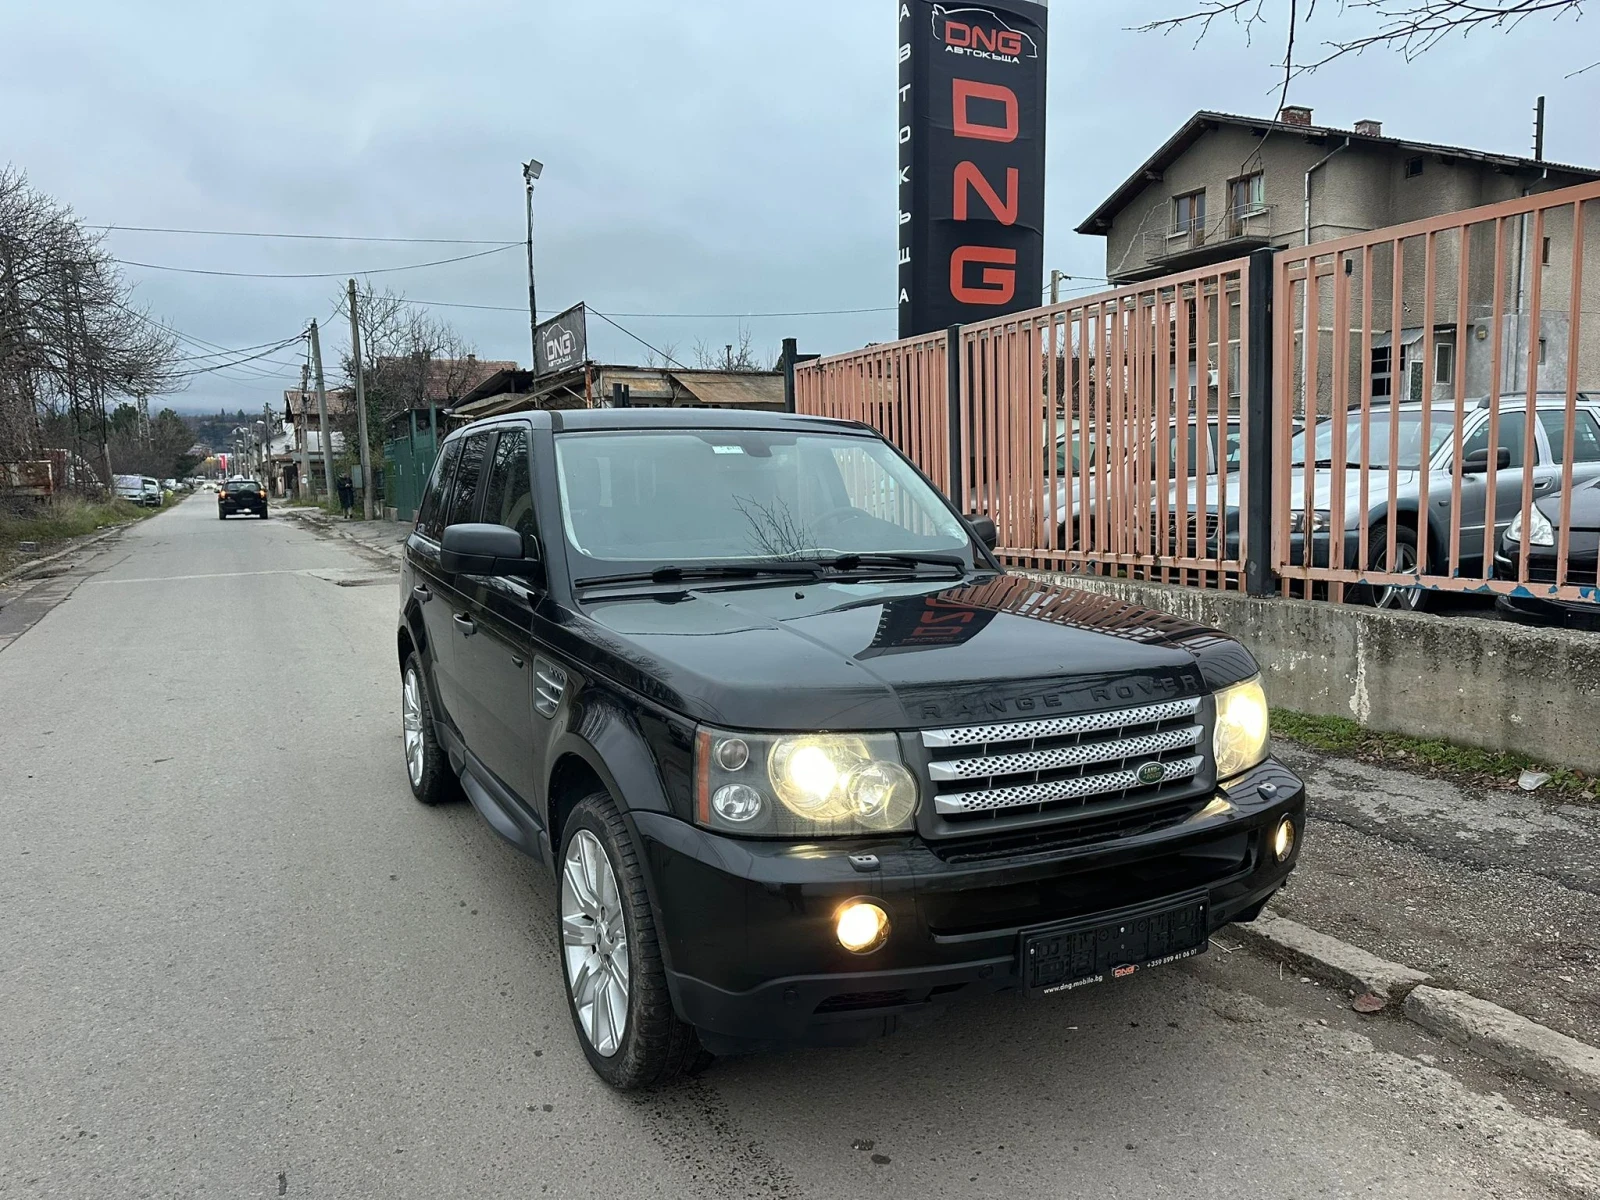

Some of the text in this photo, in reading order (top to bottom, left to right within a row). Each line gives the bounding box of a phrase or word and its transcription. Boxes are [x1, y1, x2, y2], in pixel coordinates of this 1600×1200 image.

[945, 20, 1022, 56] DNG
[944, 45, 1020, 64] АВТОКЪЩА
[950, 78, 1019, 305] DNG
[546, 333, 571, 361] DNG
[920, 674, 1199, 719] RANGE ROVER
[1146, 959, 1162, 968] +359
[1163, 955, 1174, 964] 899
[1043, 975, 1103, 994] www.dng.mobile.bg
